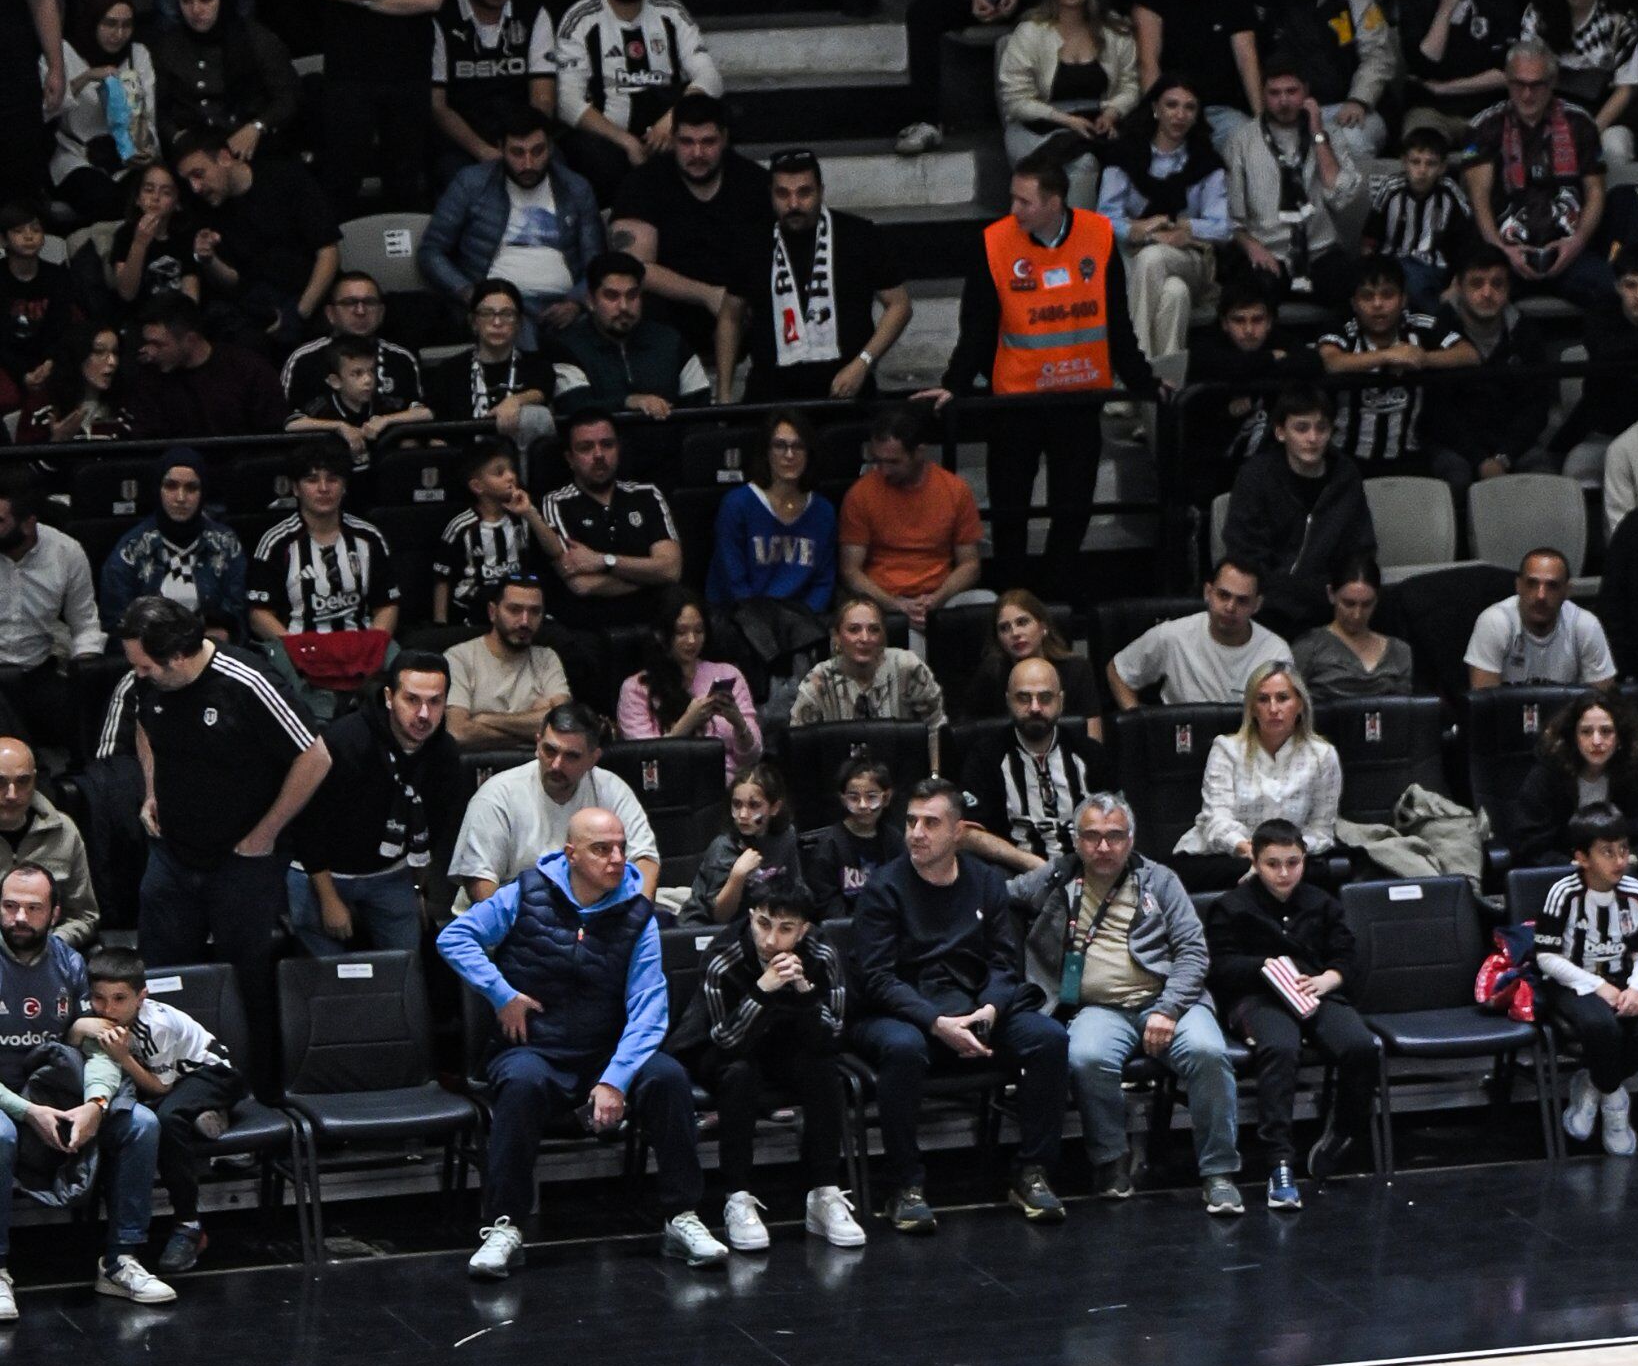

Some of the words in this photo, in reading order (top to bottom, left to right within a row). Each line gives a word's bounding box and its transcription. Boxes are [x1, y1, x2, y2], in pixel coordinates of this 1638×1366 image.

[455, 57, 526, 78] BEKO
[753, 535, 815, 567] LOVE
[481, 561, 521, 579] beko
[311, 592, 360, 612] beko
[1584, 938, 1627, 955] beko
